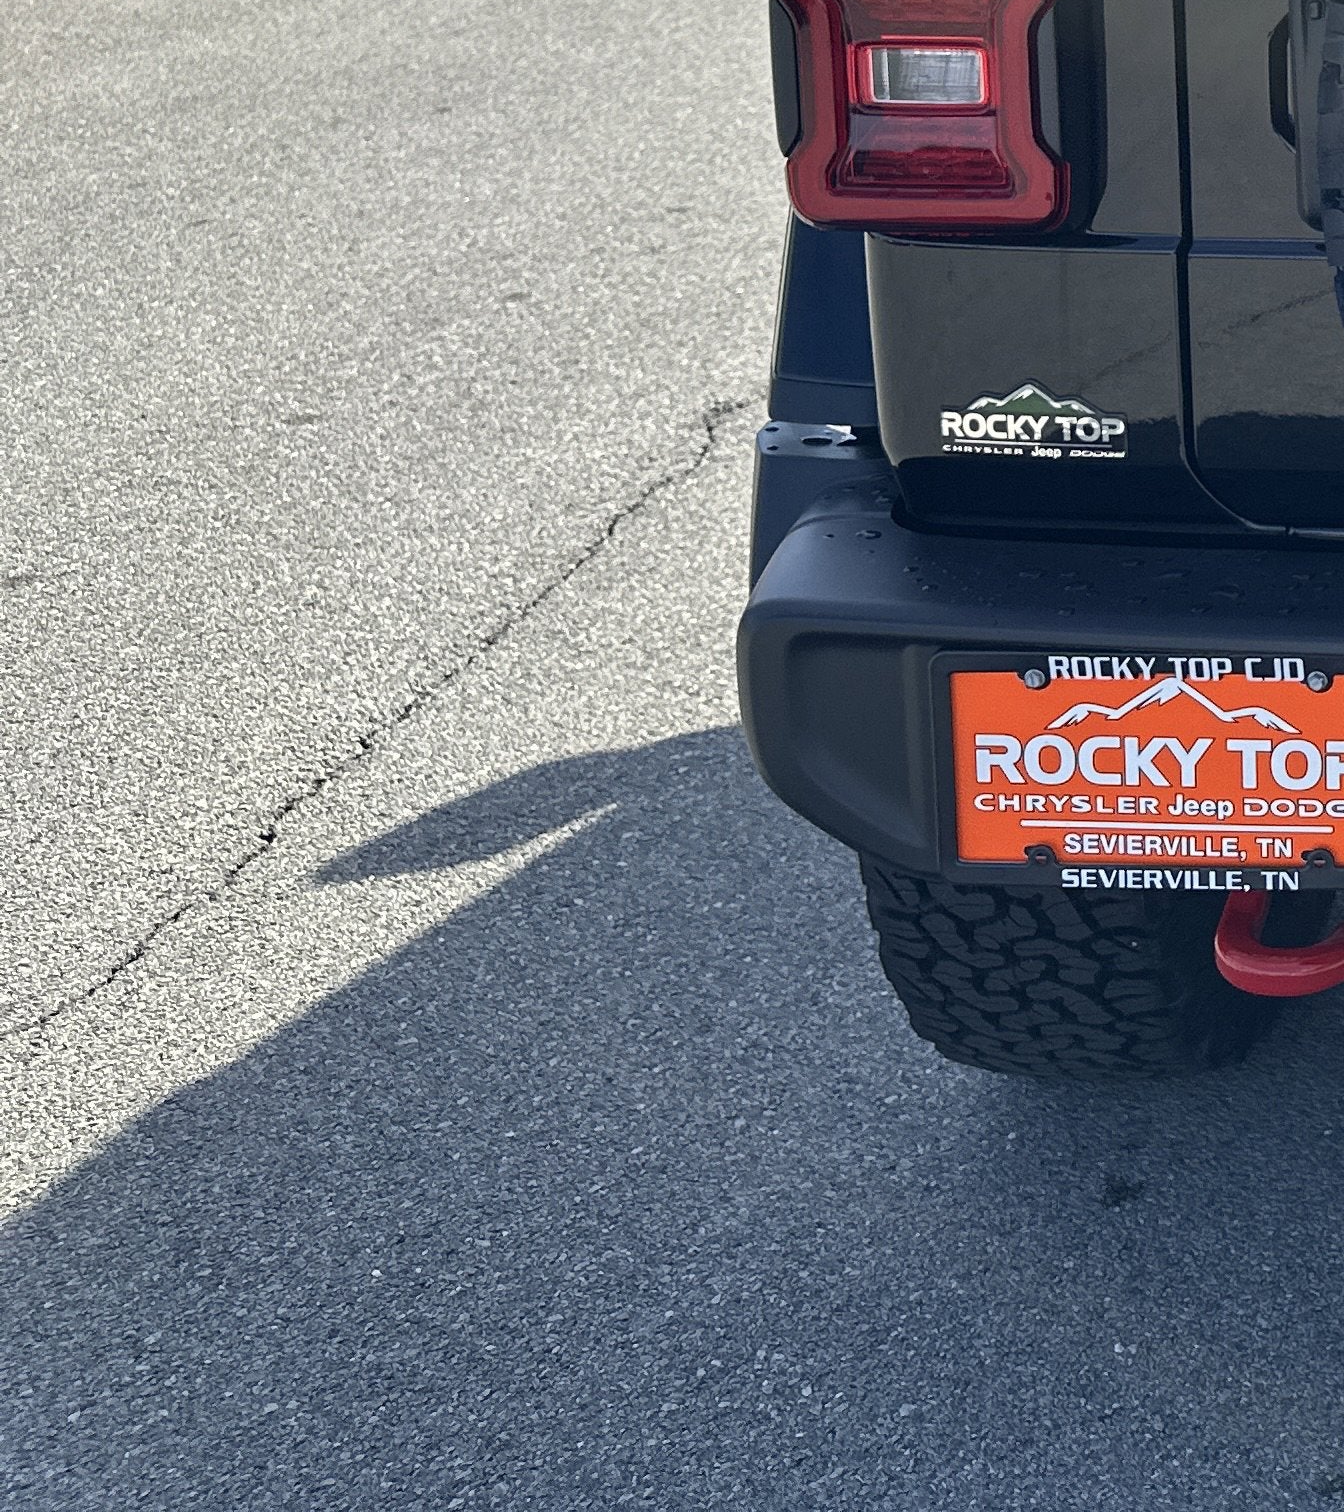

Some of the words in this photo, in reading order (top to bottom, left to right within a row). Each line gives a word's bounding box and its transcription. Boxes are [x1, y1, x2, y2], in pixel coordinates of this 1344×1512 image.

[941, 411, 1049, 440] ROCKY
[1055, 416, 1125, 443] TOP
[942, 445, 1024, 455] CHRYSLER
[1031, 446, 1062, 459] Jeep
[1048, 656, 1155, 680] ROCKY
[1168, 659, 1233, 681] TOP
[1245, 658, 1304, 682] CJD
[973, 733, 1215, 788] ROCKY
[973, 792, 1160, 815] CHRYSLER
[1168, 794, 1234, 820] Jeep
[1064, 834, 1247, 862] SEVIERVILLE,
[1255, 836, 1294, 858] TN
[1061, 869, 1252, 892] SEVIERVILLE,
[1260, 871, 1299, 891] TN
